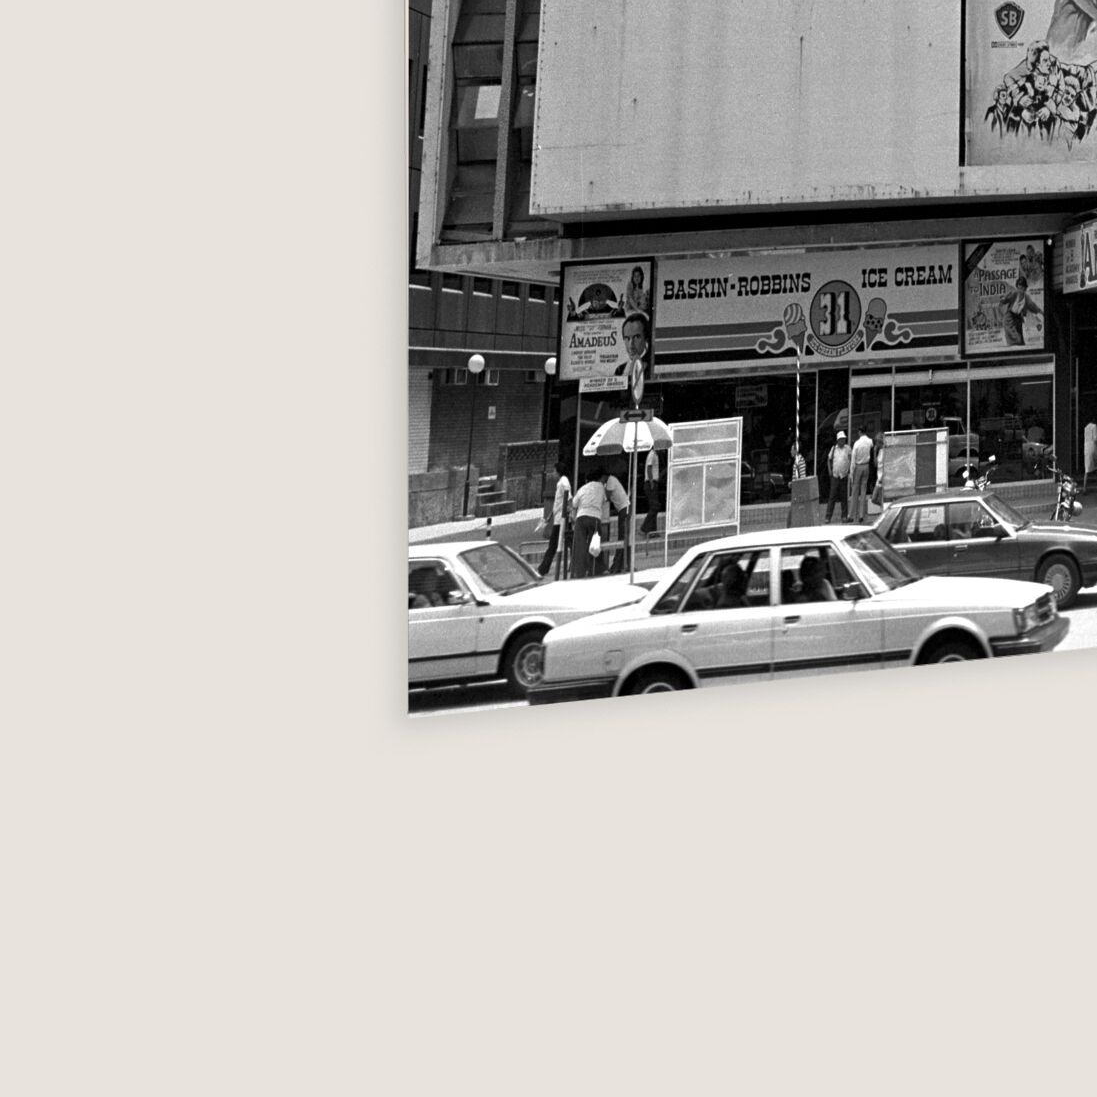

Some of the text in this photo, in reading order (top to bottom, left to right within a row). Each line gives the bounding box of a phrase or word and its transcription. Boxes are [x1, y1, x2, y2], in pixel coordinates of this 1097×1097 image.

[1000, 10, 1017, 27] SB
[663, 264, 952, 300] BASKIN-ROBBINS ICE CREAM
[979, 268, 1017, 281] PASSAGE
[980, 283, 1006, 296] INDIA
[819, 290, 851, 336] 31
[569, 331, 617, 348] AMADEUS
